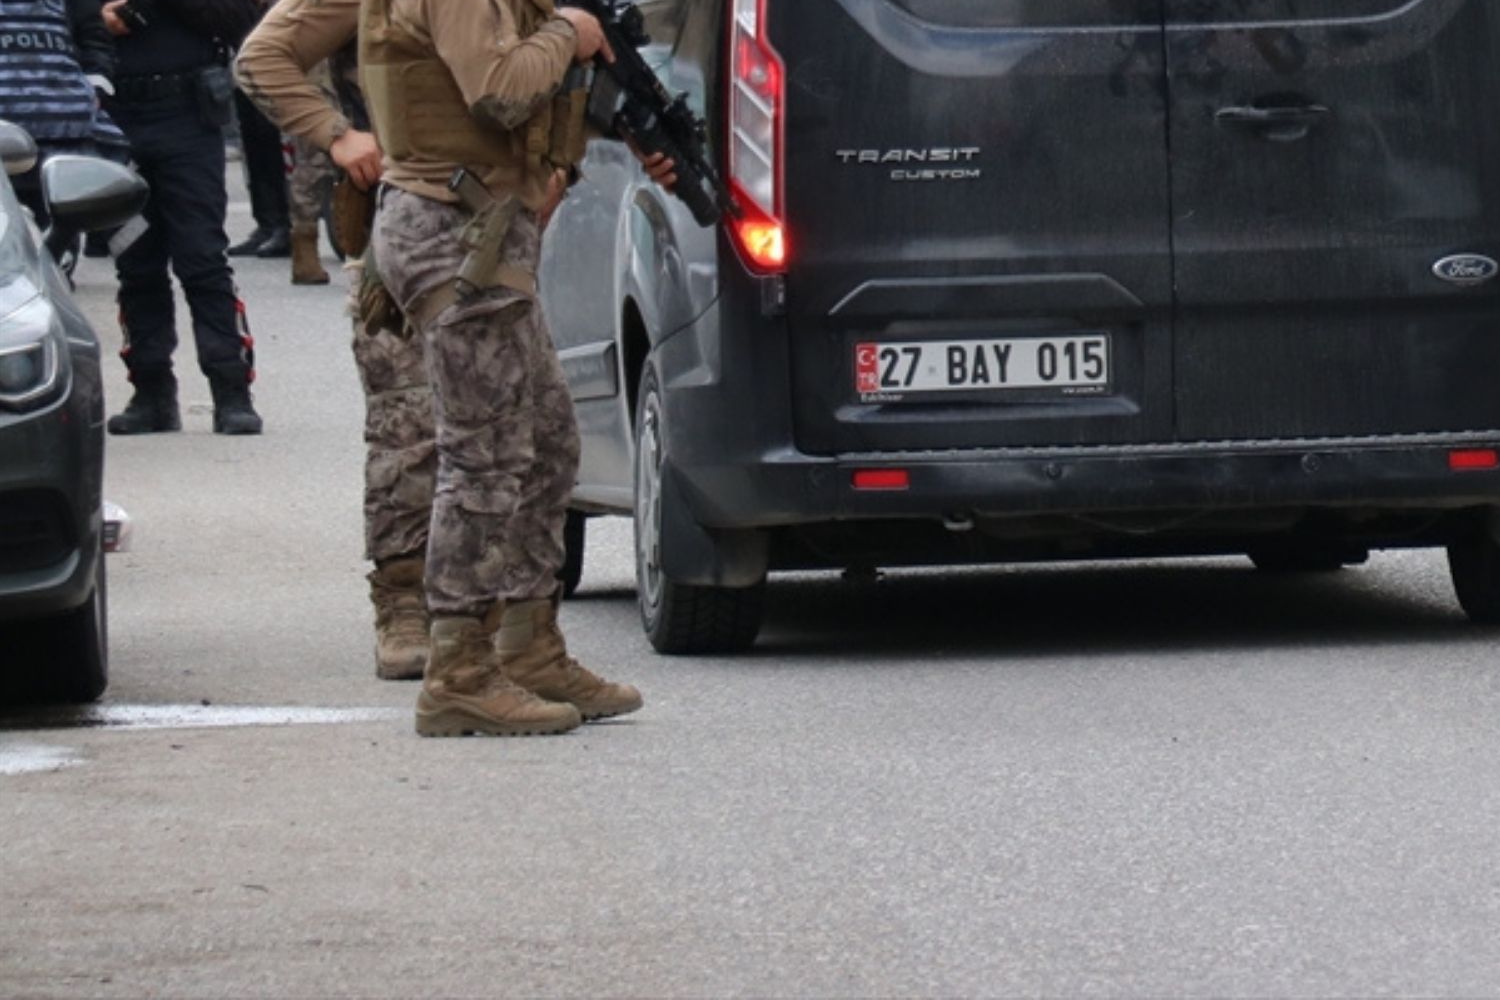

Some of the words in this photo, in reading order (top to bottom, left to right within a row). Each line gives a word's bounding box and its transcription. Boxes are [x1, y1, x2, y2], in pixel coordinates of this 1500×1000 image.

[836, 147, 980, 163] TRANSIT
[890, 169, 981, 180] CUSTOM
[1448, 259, 1486, 277] Ford
[880, 347, 922, 388] 27
[946, 344, 1012, 387] BAY
[1037, 341, 1104, 382] 015
